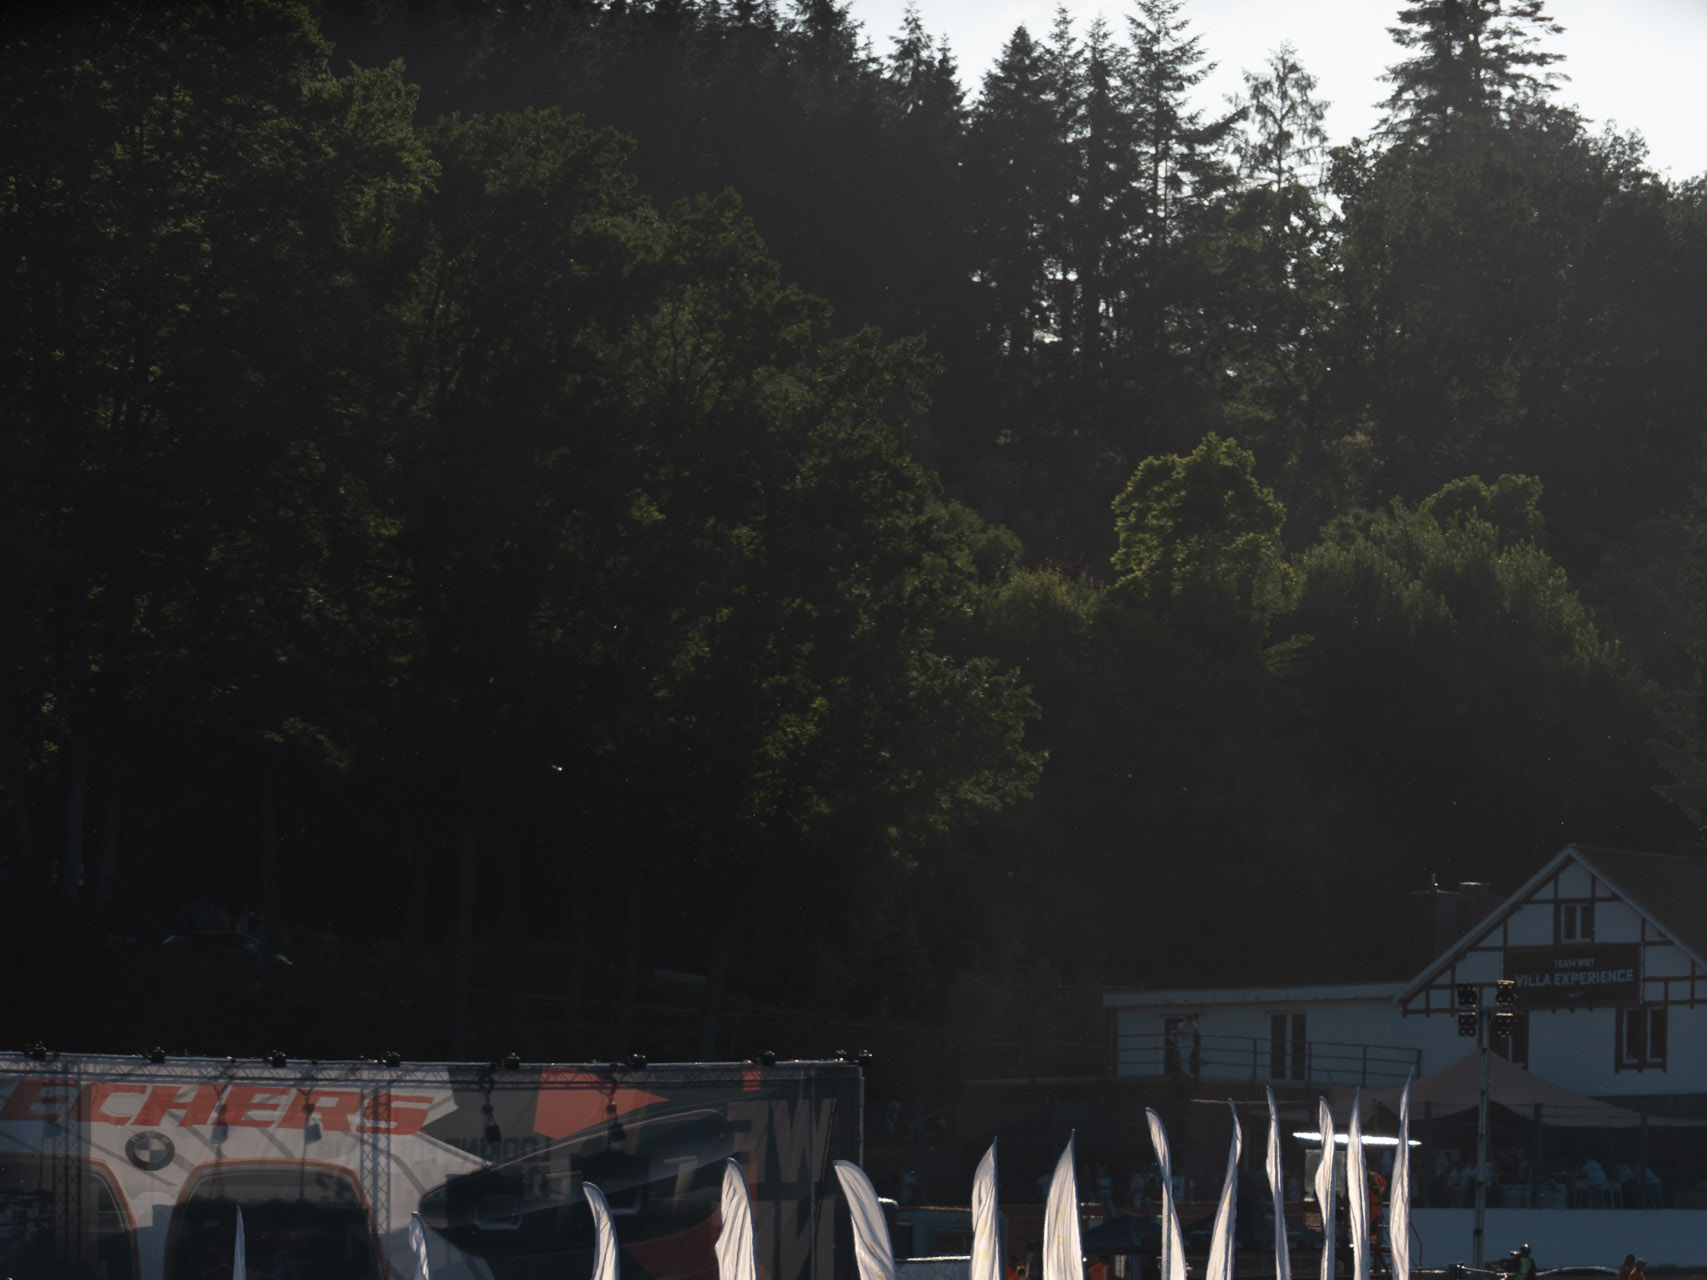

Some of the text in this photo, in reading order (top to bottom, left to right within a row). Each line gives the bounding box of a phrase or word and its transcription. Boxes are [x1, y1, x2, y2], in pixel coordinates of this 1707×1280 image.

[1553, 957, 1597, 968] TEAM WRT
[1514, 968, 1634, 988] VILLA EXPERIENCE
[0, 1079, 434, 1135] ECHERS
